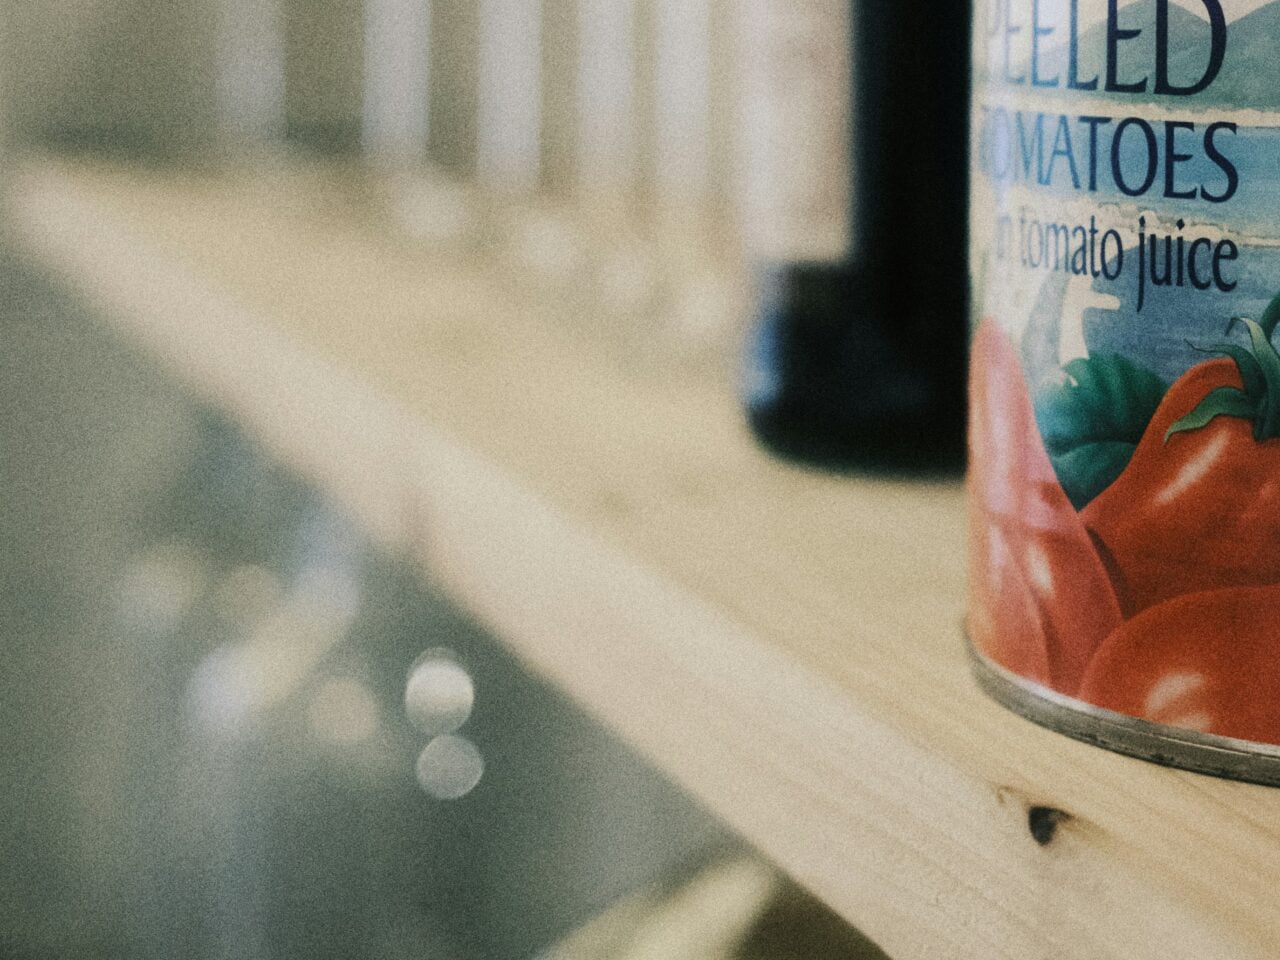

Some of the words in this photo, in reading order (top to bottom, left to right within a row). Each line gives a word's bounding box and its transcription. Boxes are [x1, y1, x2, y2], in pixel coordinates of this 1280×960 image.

[979, 104, 1239, 204] OMATOES
[1019, 205, 1124, 282] tomato
[1136, 215, 1239, 313] juice
